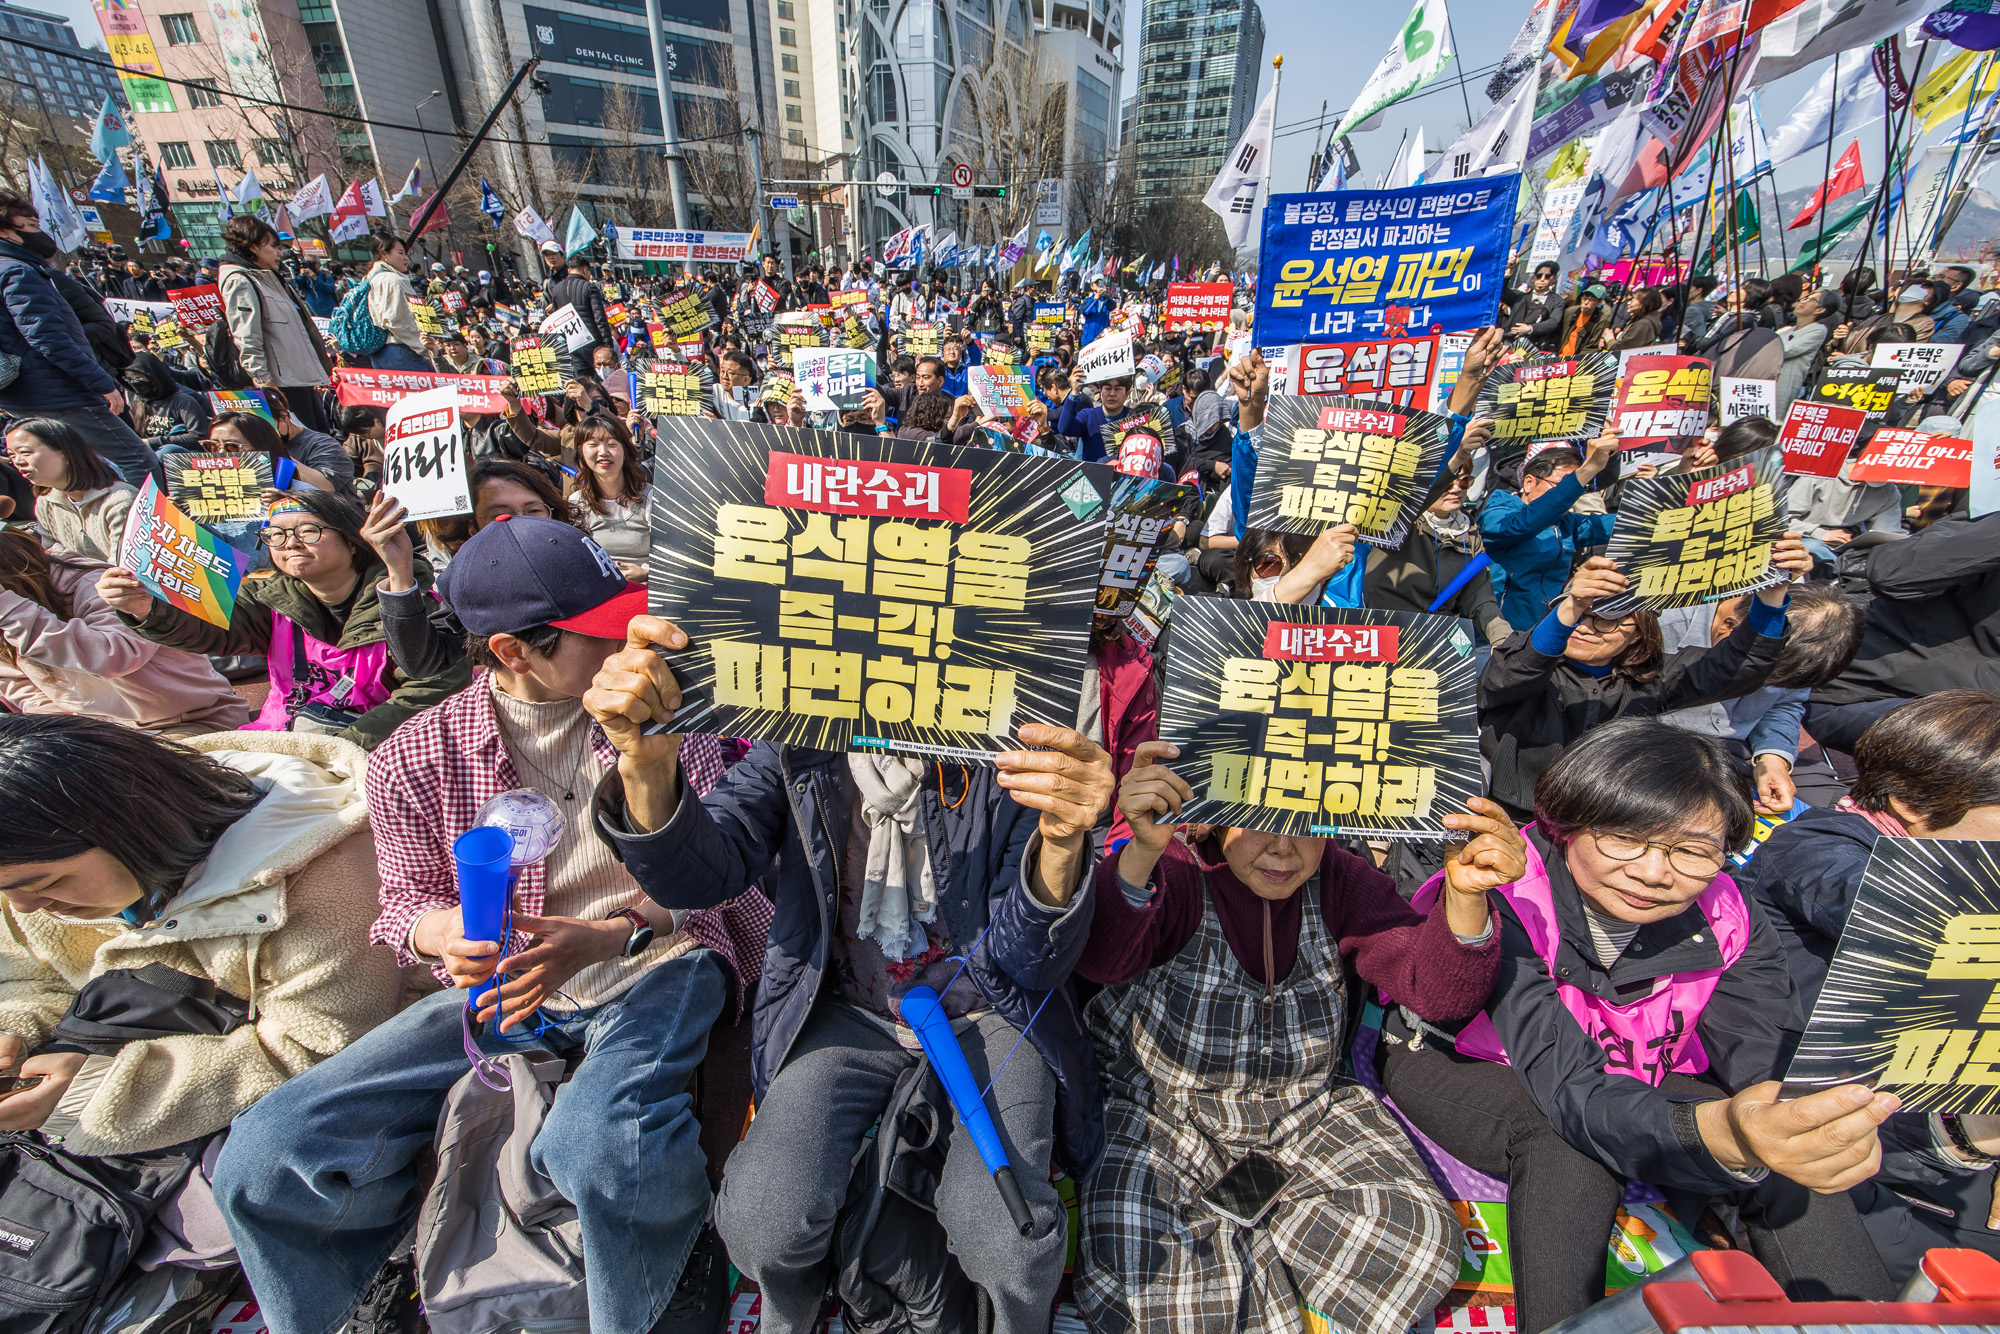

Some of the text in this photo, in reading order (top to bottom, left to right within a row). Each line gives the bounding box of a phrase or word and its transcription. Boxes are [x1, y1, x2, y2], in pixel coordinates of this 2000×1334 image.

[575, 47, 644, 66] DENTAL CLINIC
[74, 192, 86, 201] 50
[1284, 189, 1493, 226] 불공정, 몰상식의 편법으로
[632, 230, 704, 244] 범국민항쟁으로
[1310, 223, 1452, 252] 헌정질서 파괴하는
[634, 242, 746, 261] 내란세력 완전청산!
[1272, 252, 1386, 308] 윤석열
[194, 292, 222, 309] 파면
[1170, 294, 1230, 306] 마침내 윤석열 파면
[1168, 307, 1229, 318] 새봄에는 새나라로
[1309, 311, 1356, 336] 나라
[798, 356, 826, 370] 내란수괴
[827, 352, 868, 376] 즉각
[1895, 347, 1945, 364] 탄핵은
[653, 363, 683, 374] 내란수괴
[798, 365, 826, 382] 윤석열
[1302, 339, 1434, 395] 윤석열
[1520, 361, 1568, 379] 내란수괴
[345, 373, 376, 389] 나는
[377, 374, 433, 392] 윤석열이
[644, 371, 701, 391] 윤석열을
[827, 373, 868, 398] 파면
[972, 373, 1031, 385] 성소수자 차별도
[1497, 374, 1595, 405] 윤석열을
[985, 385, 1019, 396] 윤석열도
[1734, 383, 1763, 399] 탄핵은
[232, 397, 264, 410] 차별도
[645, 397, 701, 416] 파면하라
[980, 396, 1023, 407] 없는 사회로
[1727, 401, 1771, 420] 시작이다
[401, 410, 449, 435] 국민의힘
[1327, 410, 1396, 433] 내란수괴
[1492, 411, 1588, 439] 파면하라
[1790, 404, 1830, 425] 탄핵은
[1796, 421, 1857, 446] 끝이 아니라
[1874, 429, 1932, 446] 탄핵은
[1289, 427, 1423, 479] 윤석열을
[1780, 436, 1826, 459] 시작이다
[1883, 442, 1921, 458] 끝이
[196, 457, 234, 469] 내란수괴
[1858, 453, 1936, 471] 시작이다
[182, 467, 258, 487] 윤석열을
[786, 461, 941, 513] 내란수괴
[1695, 468, 1750, 500] 내란수괴
[188, 498, 262, 517] 파면하라
[1278, 484, 1403, 533] 파면하라
[1651, 483, 1774, 543] 윤석열을
[136, 493, 233, 579] 성소수자 차별도
[133, 528, 195, 581] 윤석열도
[712, 503, 1033, 611] 윤석열을
[1100, 543, 1153, 590] 면
[1634, 542, 1773, 597] 파면하라
[141, 565, 202, 603] 사회로
[1280, 627, 1379, 657] 내란수괴
[711, 638, 1018, 737] 파면하라
[1219, 656, 1439, 723] 윤석열을
[1206, 752, 1438, 819] 파면하라
[7, 1232, 36, 1248] PETERS
